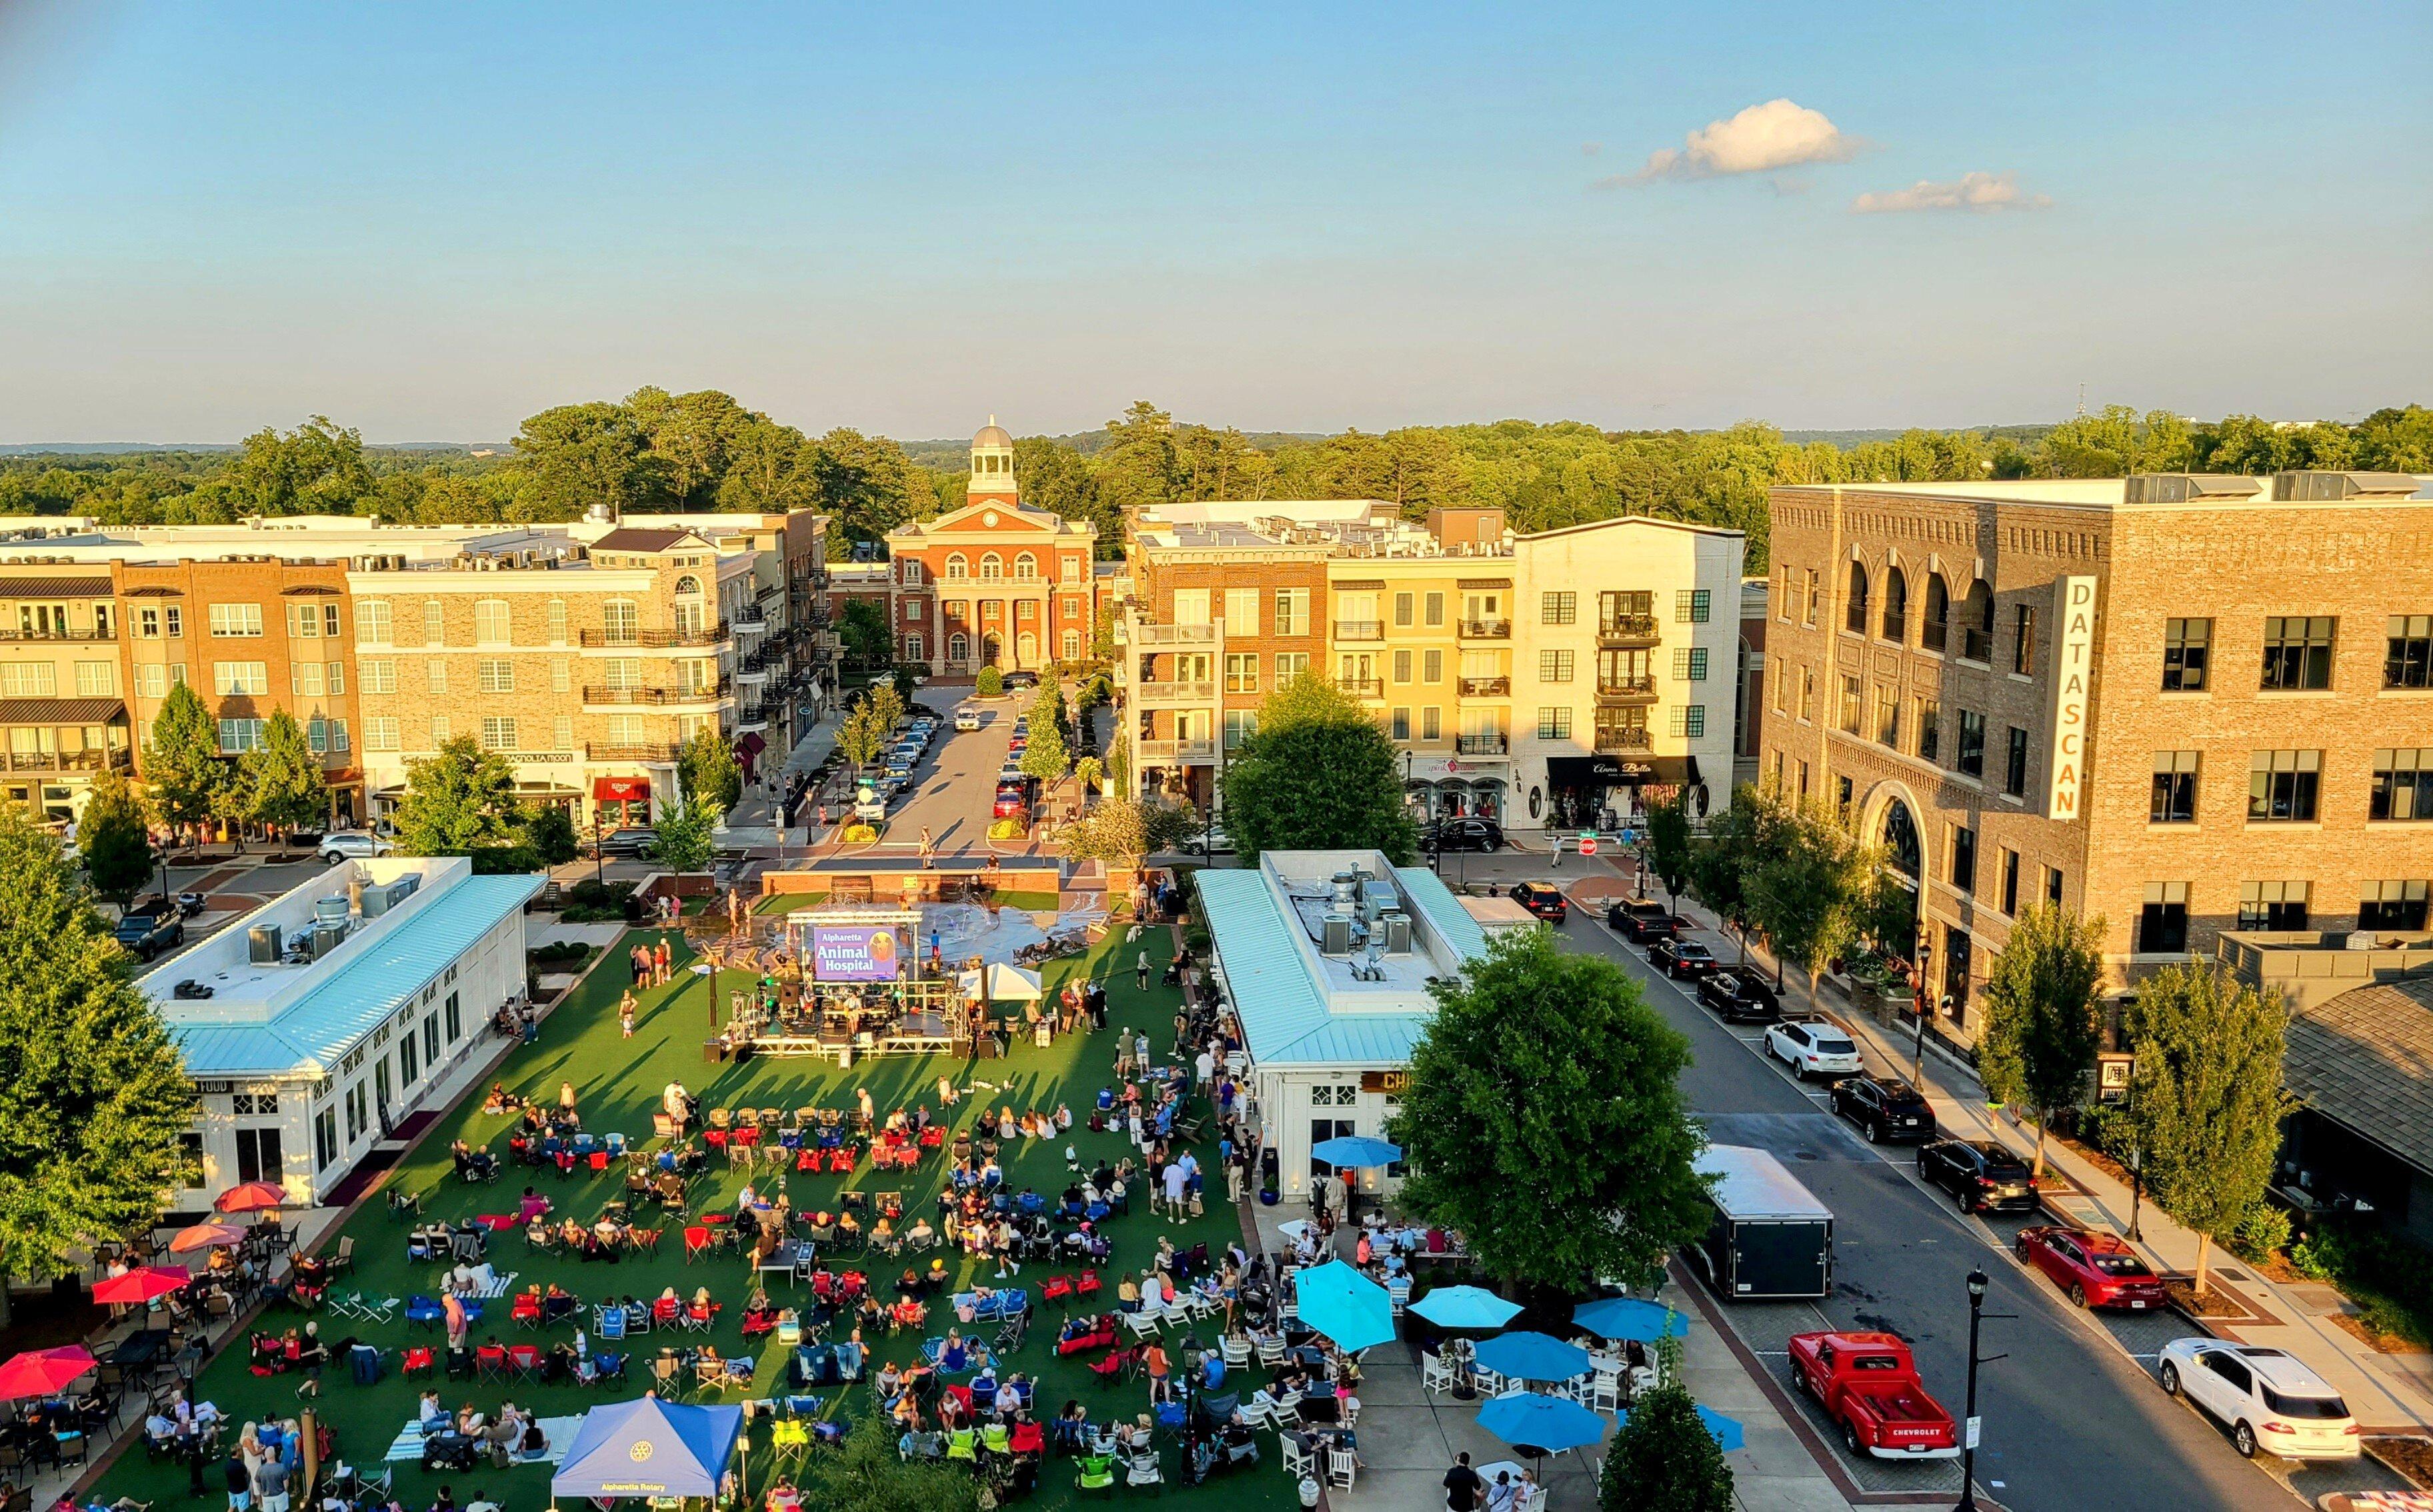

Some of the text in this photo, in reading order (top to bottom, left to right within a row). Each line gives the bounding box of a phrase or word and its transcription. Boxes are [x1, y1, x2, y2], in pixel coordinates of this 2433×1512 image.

[2056, 584, 2090, 811] DATASCAN
[1593, 763, 1652, 773] Anna Bella
[822, 933, 862, 943] Alpharetta
[817, 945, 868, 959] Animal
[825, 959, 873, 973] Hospital
[201, 1080, 227, 1092] FOOD
[601, 1483, 665, 1493] Alpharetta Rotary
